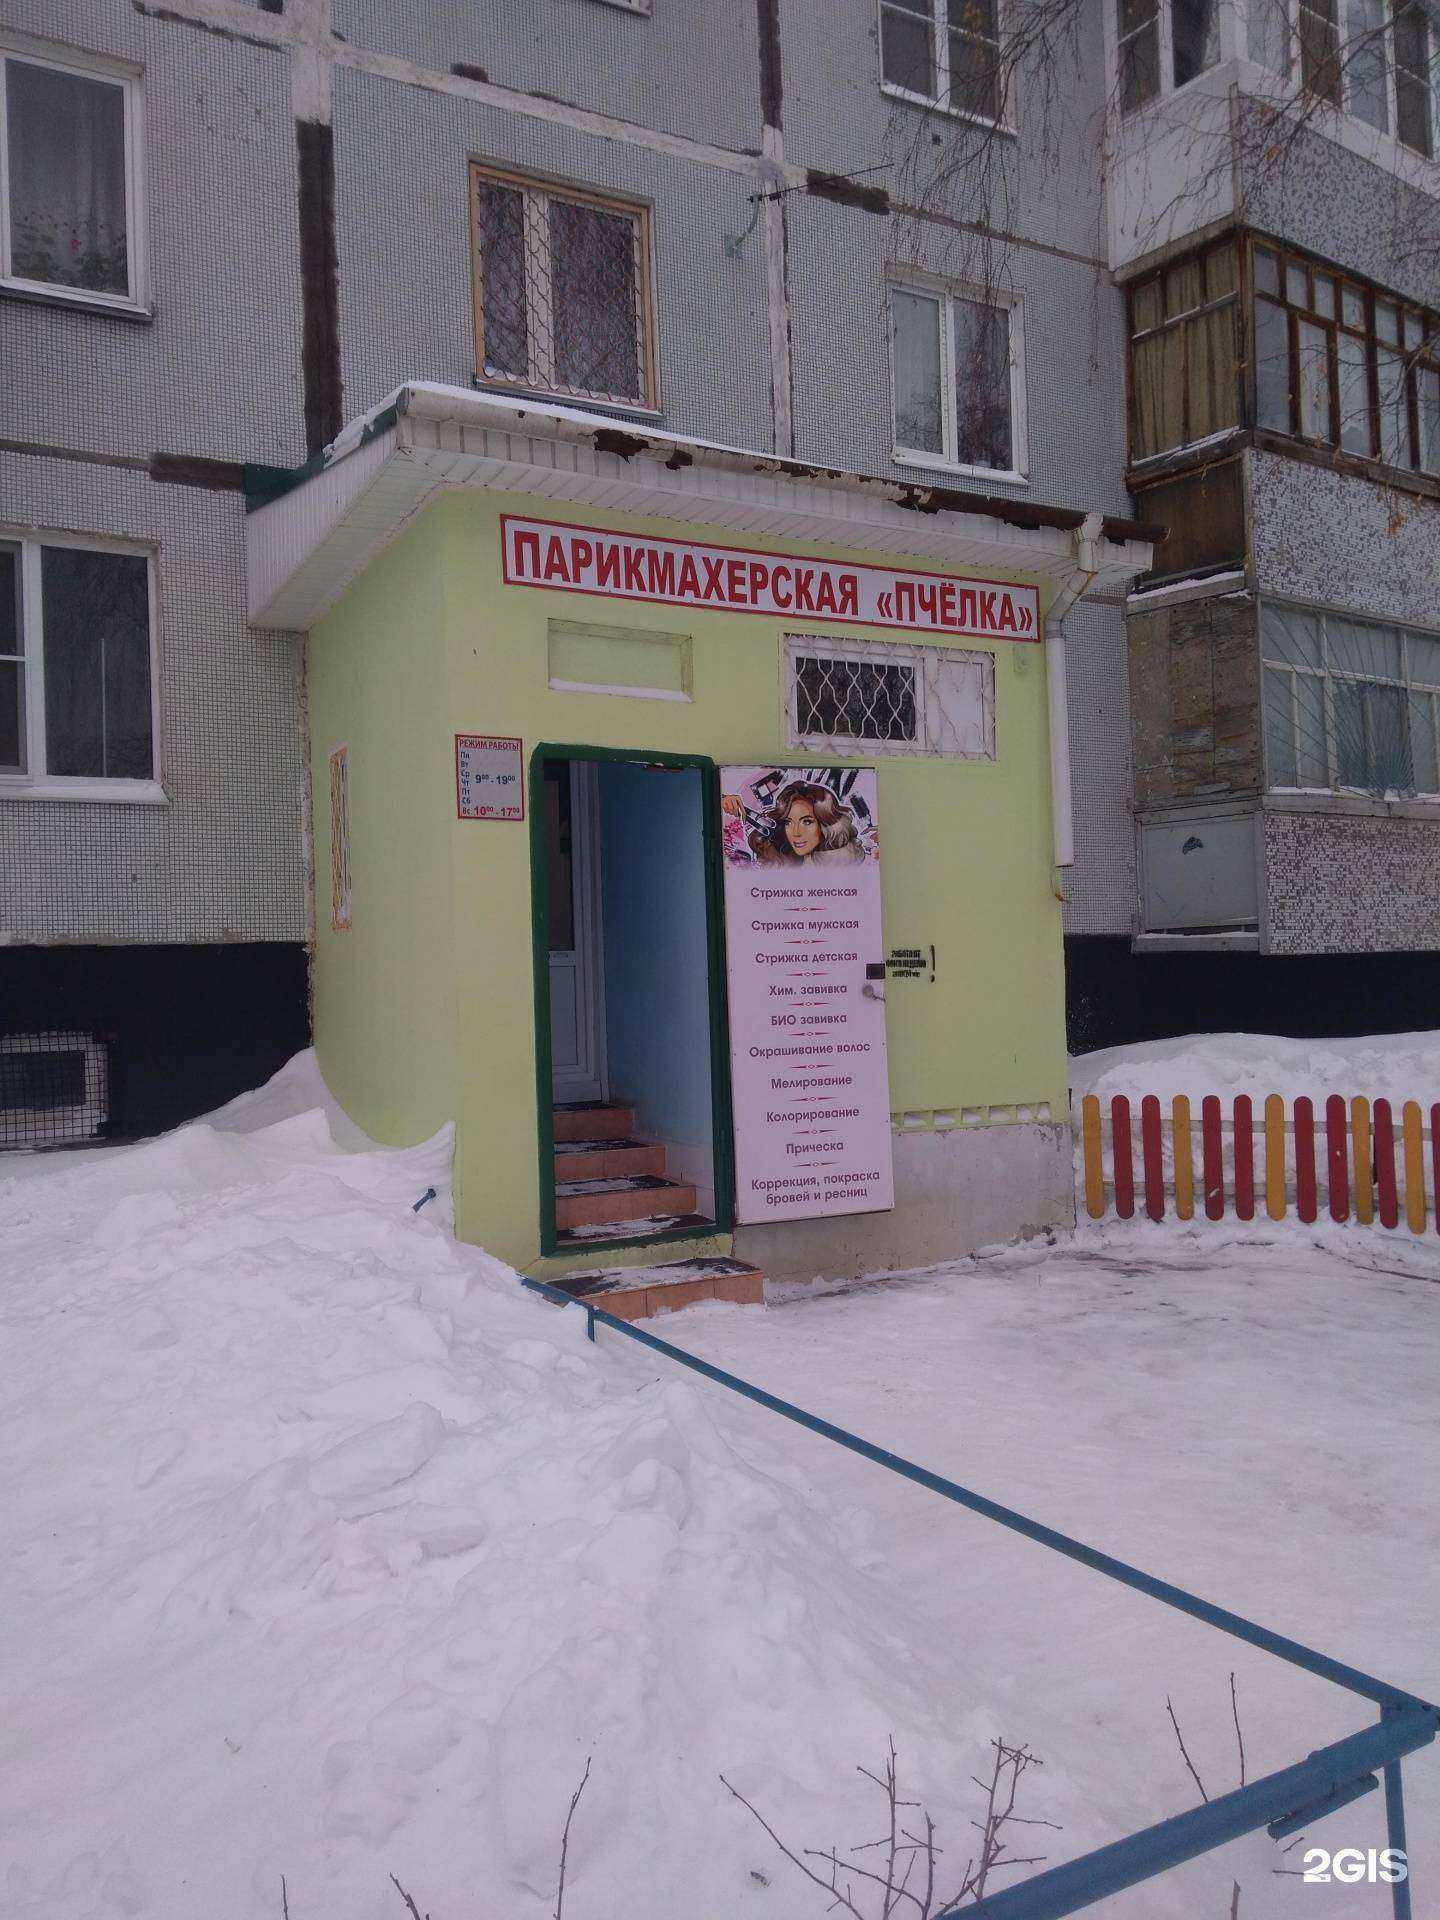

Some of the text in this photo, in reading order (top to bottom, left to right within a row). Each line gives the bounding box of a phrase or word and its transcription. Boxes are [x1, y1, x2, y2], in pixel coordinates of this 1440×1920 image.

[514, 530, 1034, 633] ПАРИКМАХЕРСКАЯ «ПЧЁЛКА»
[460, 740, 519, 751] РЕЖИМ РАБОТЫ
[461, 770, 470, 778] Ср
[750, 887, 858, 900] Стрижка женская
[751, 919, 859, 933] Стрижка мужская
[756, 952, 858, 966] Стрижка детская
[769, 984, 847, 996] Хим. завивка
[771, 1014, 847, 1026] БИО завивка
[750, 1042, 870, 1059] Окрашивание волос
[771, 1075, 852, 1090] Мелирование
[766, 1107, 860, 1123] Колорирование
[786, 1141, 844, 1155] Прическа
[751, 1170, 880, 1191] Коррекция, покраска
[766, 1192, 810, 1206] бровей
[824, 1187, 868, 1202] ресниц
